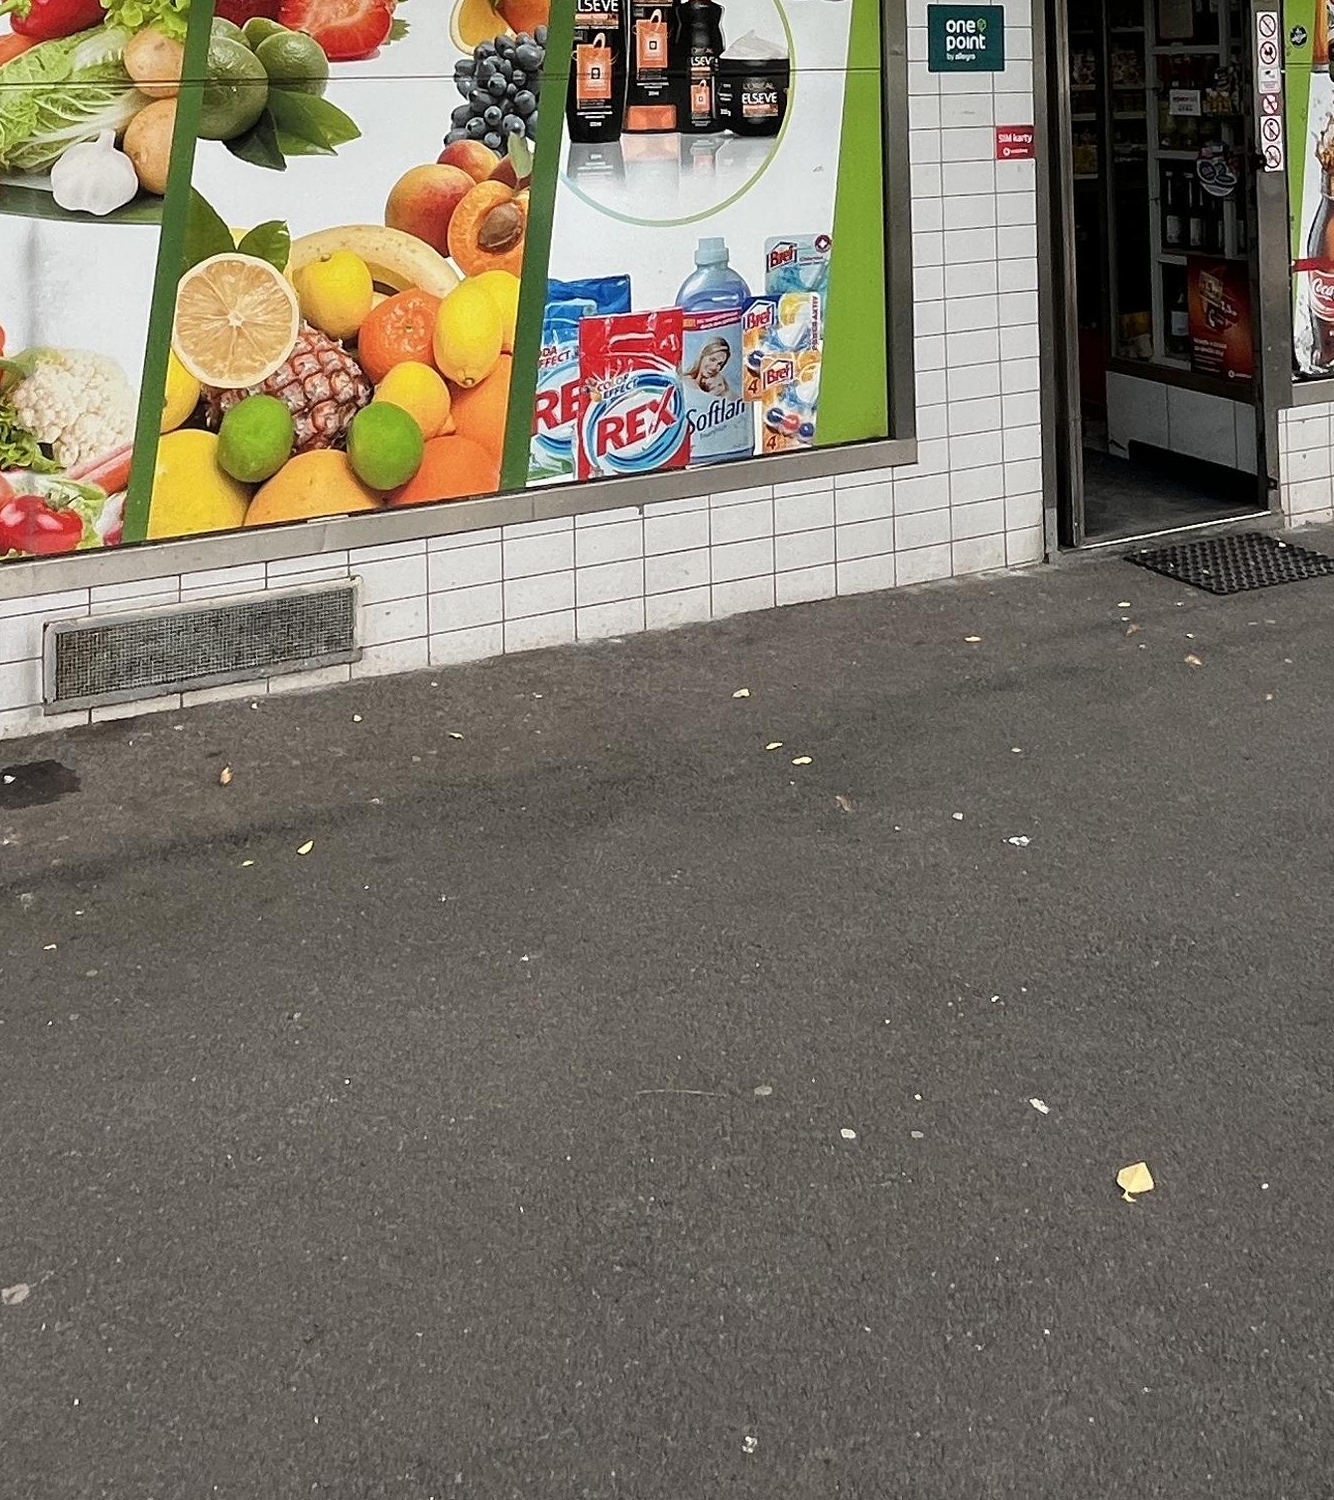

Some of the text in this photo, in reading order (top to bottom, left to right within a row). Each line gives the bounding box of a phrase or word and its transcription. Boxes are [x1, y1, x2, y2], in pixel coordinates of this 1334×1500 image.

[945, 19, 976, 34] one
[945, 33, 986, 52] point
[741, 91, 778, 105] ELSEVE
[770, 245, 794, 268] Bref
[747, 306, 771, 331] Bref
[767, 363, 790, 385] Bref
[747, 378, 759, 394] 4
[534, 378, 581, 435] RE
[685, 398, 746, 435] Softlan
[596, 384, 677, 458] REX
[766, 435, 777, 450] 4
